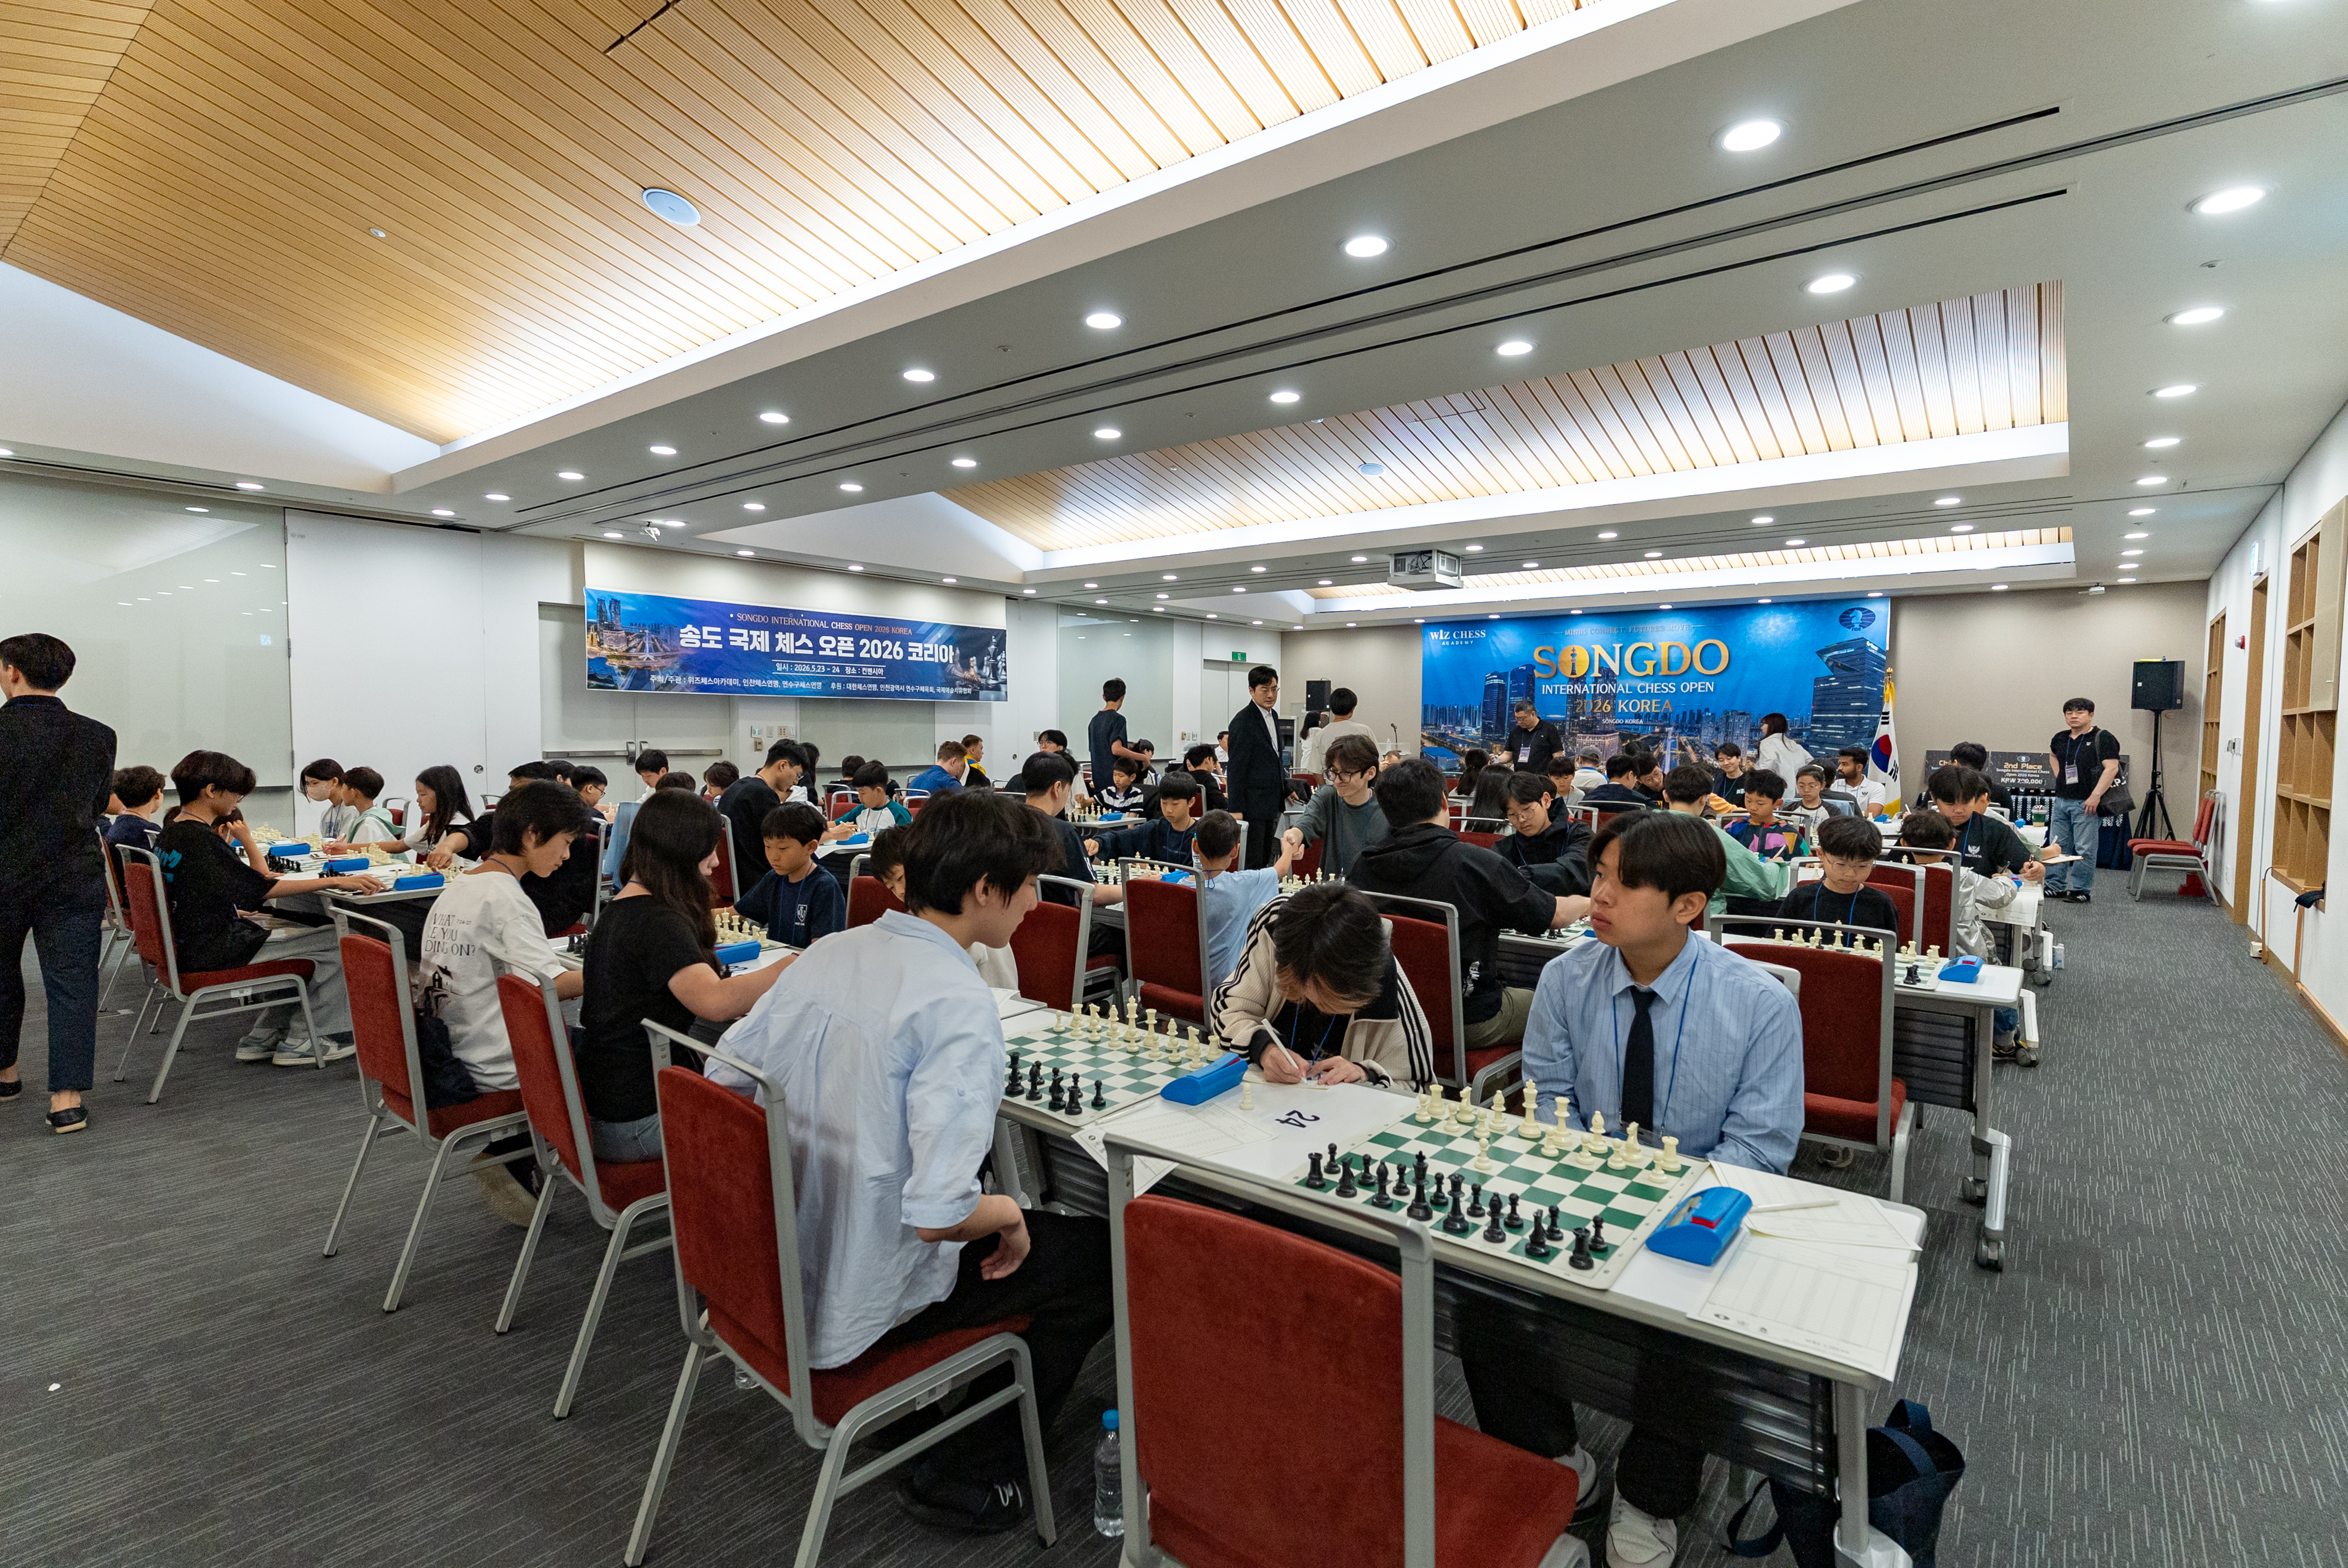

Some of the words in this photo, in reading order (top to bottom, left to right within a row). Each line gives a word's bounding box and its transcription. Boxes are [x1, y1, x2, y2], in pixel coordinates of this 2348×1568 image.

[737, 613, 768, 624] SONGDO
[771, 616, 829, 629] INTERNATIONAL
[831, 621, 853, 630] CHESS
[1453, 630, 1486, 639] CHESS
[679, 624, 723, 648] 송도
[728, 628, 770, 653] 국제
[775, 631, 814, 655] 체스
[819, 635, 855, 657] 오픈
[859, 638, 904, 660] 2026
[908, 642, 954, 664] 코리아
[1533, 639, 1729, 678] SONGDO
[775, 663, 789, 671] 일시
[794, 664, 825, 673] 2026.5.23
[862, 667, 884, 675] 컨벤시아
[649, 675, 682, 684] 주최/주관
[687, 677, 741, 687] 위즈체스아카데미,
[743, 679, 781, 688] 인천체스연맹,
[782, 681, 822, 690] 연수구체스연맹
[846, 683, 879, 692] 대한체스연맹,
[880, 684, 905, 692] 인천광역시
[906, 685, 935, 694] 연수구체육회,
[1542, 683, 1632, 695] INTERNATIONAL
[1637, 682, 1676, 694] CHESS
[1680, 681, 1714, 693] OPEN
[1576, 699, 1611, 713] 2026
[1618, 699, 1673, 713] KOREA
[441, 927, 458, 941] YOU
[451, 943, 475, 956] ON?
[1274, 1110, 1320, 1128] 24
